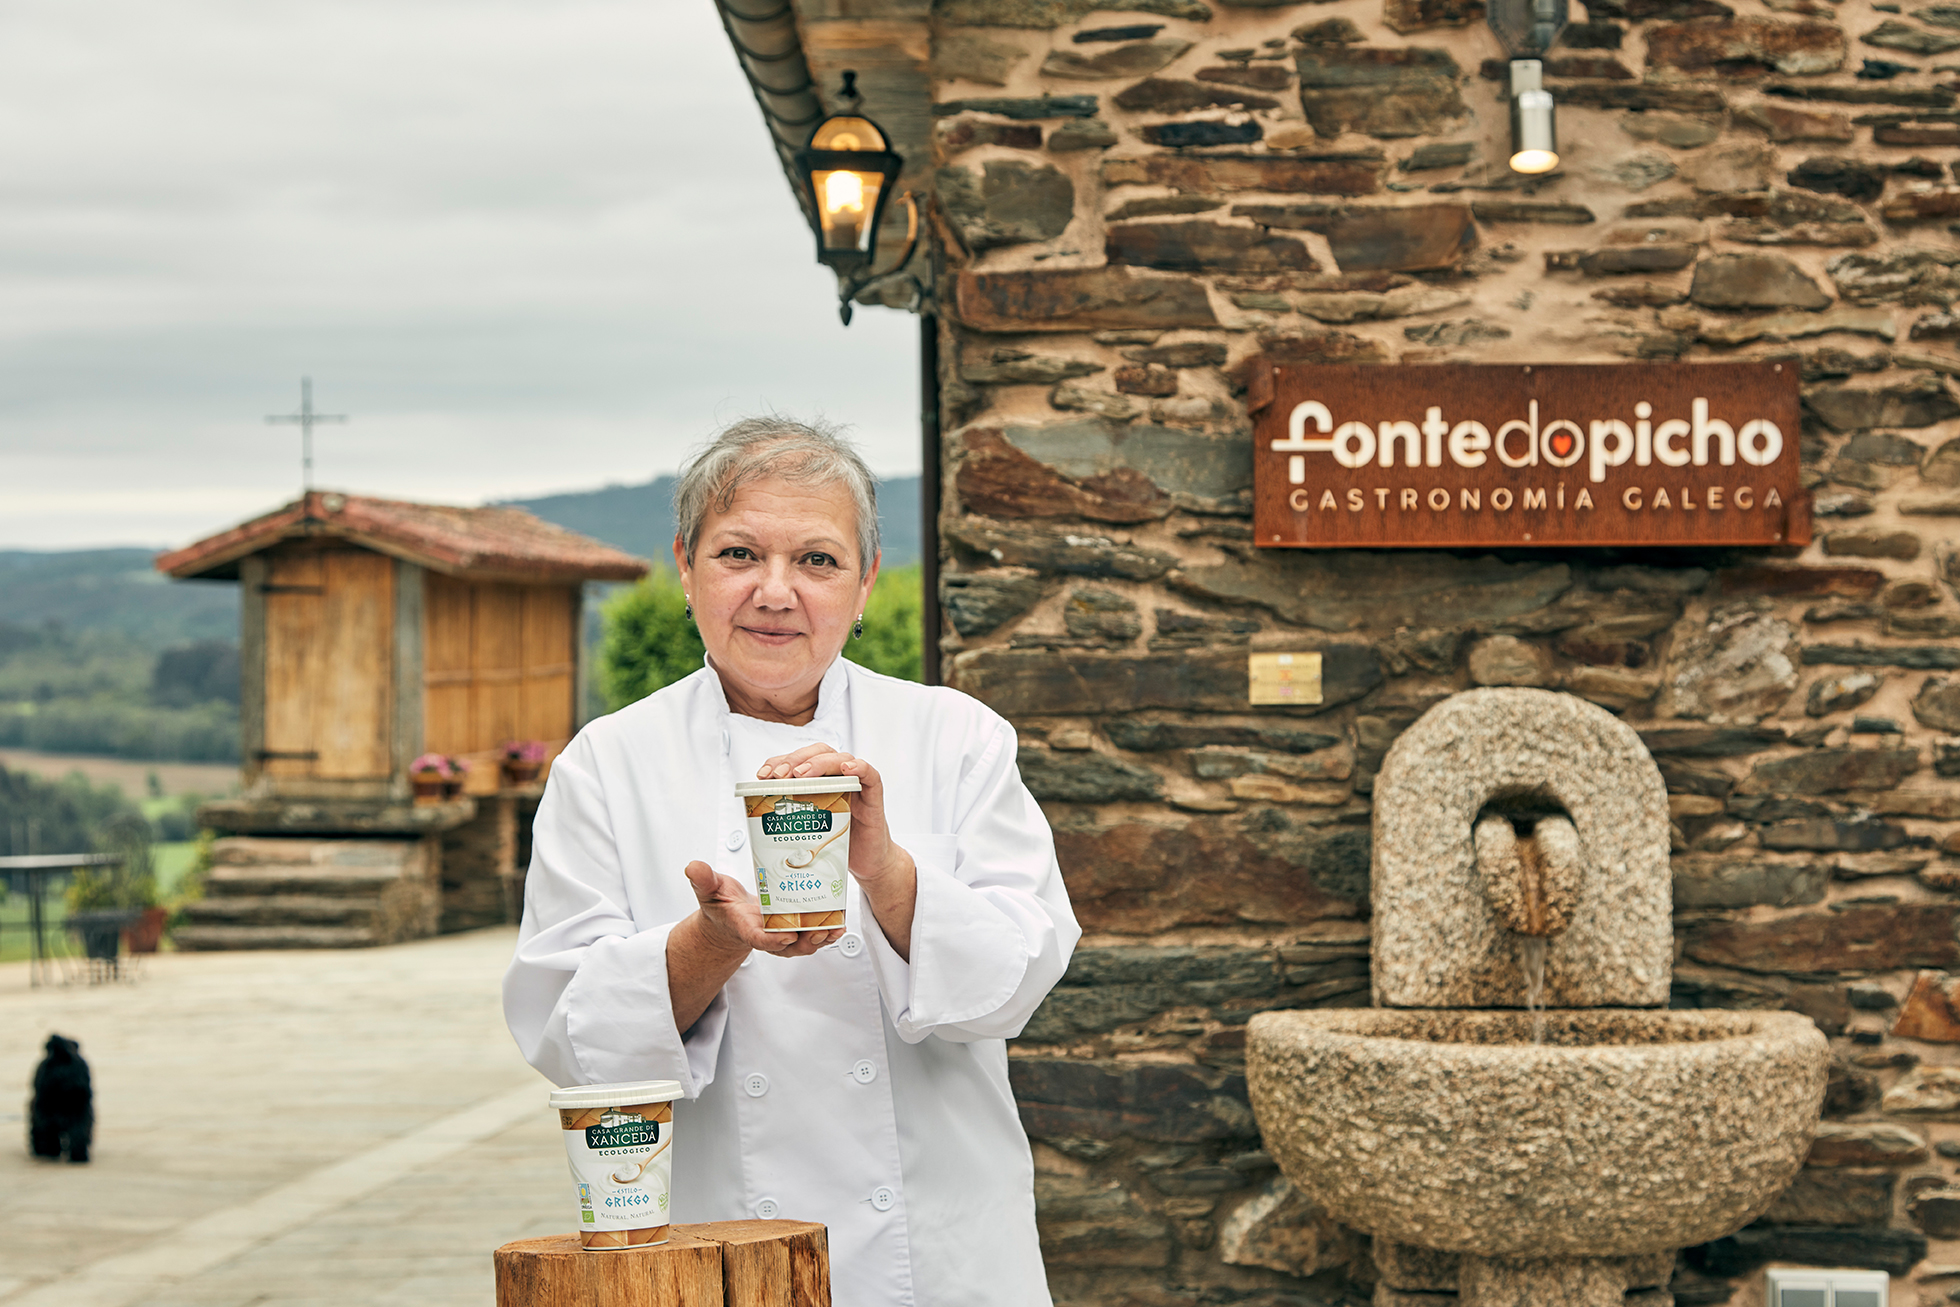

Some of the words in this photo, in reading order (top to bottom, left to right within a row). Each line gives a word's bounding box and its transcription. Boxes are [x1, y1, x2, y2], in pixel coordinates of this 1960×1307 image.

[1288, 482, 1595, 511] GASTRONOMÍA
[1622, 486, 1783, 511] GALEGA
[766, 820, 829, 832] XANCEDA
[779, 879, 822, 891] GRIEGO
[613, 1125, 644, 1133] GRANDE
[591, 1131, 656, 1146] XANCEDA
[605, 1194, 650, 1207] GRIEGO
